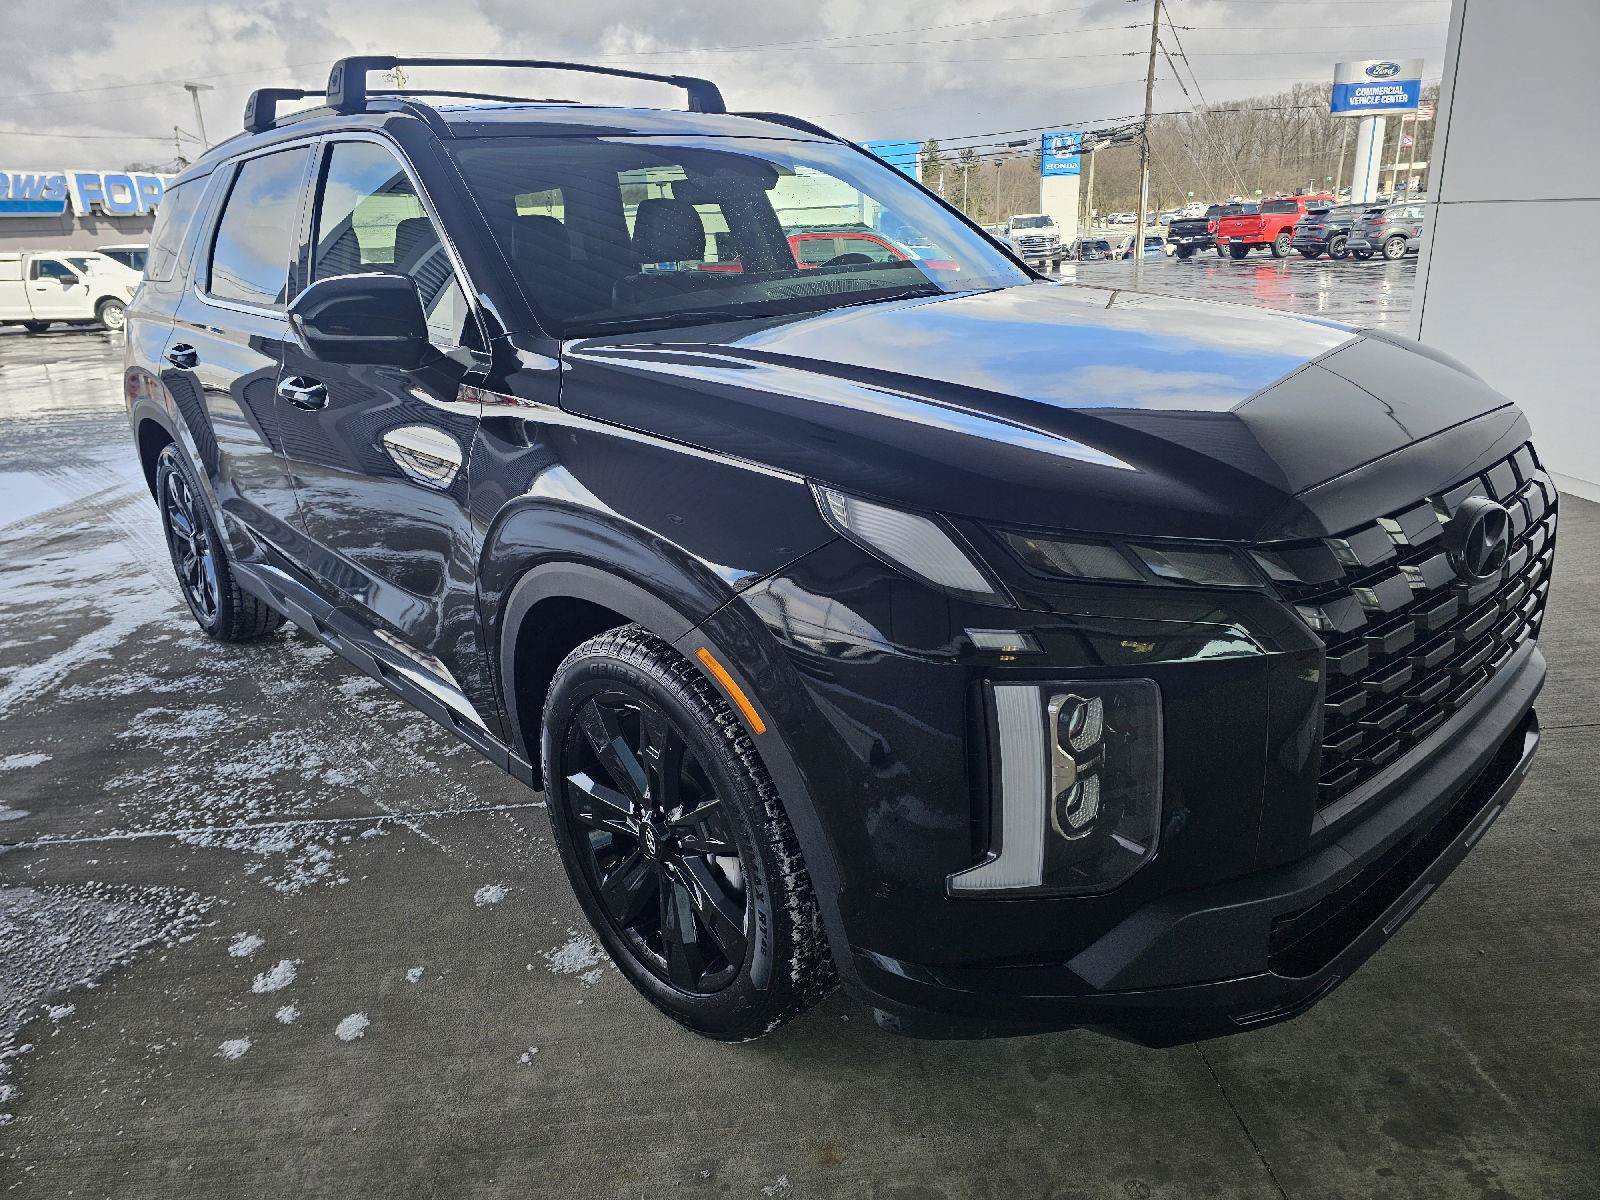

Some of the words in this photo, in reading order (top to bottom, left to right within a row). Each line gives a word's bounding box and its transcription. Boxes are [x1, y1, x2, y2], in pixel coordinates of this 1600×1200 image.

[1355, 85, 1404, 97] COMMERCIAL
[1349, 94, 1381, 106] VEHICLE
[1380, 93, 1409, 104] CENTER
[74, 171, 177, 215] FOR
